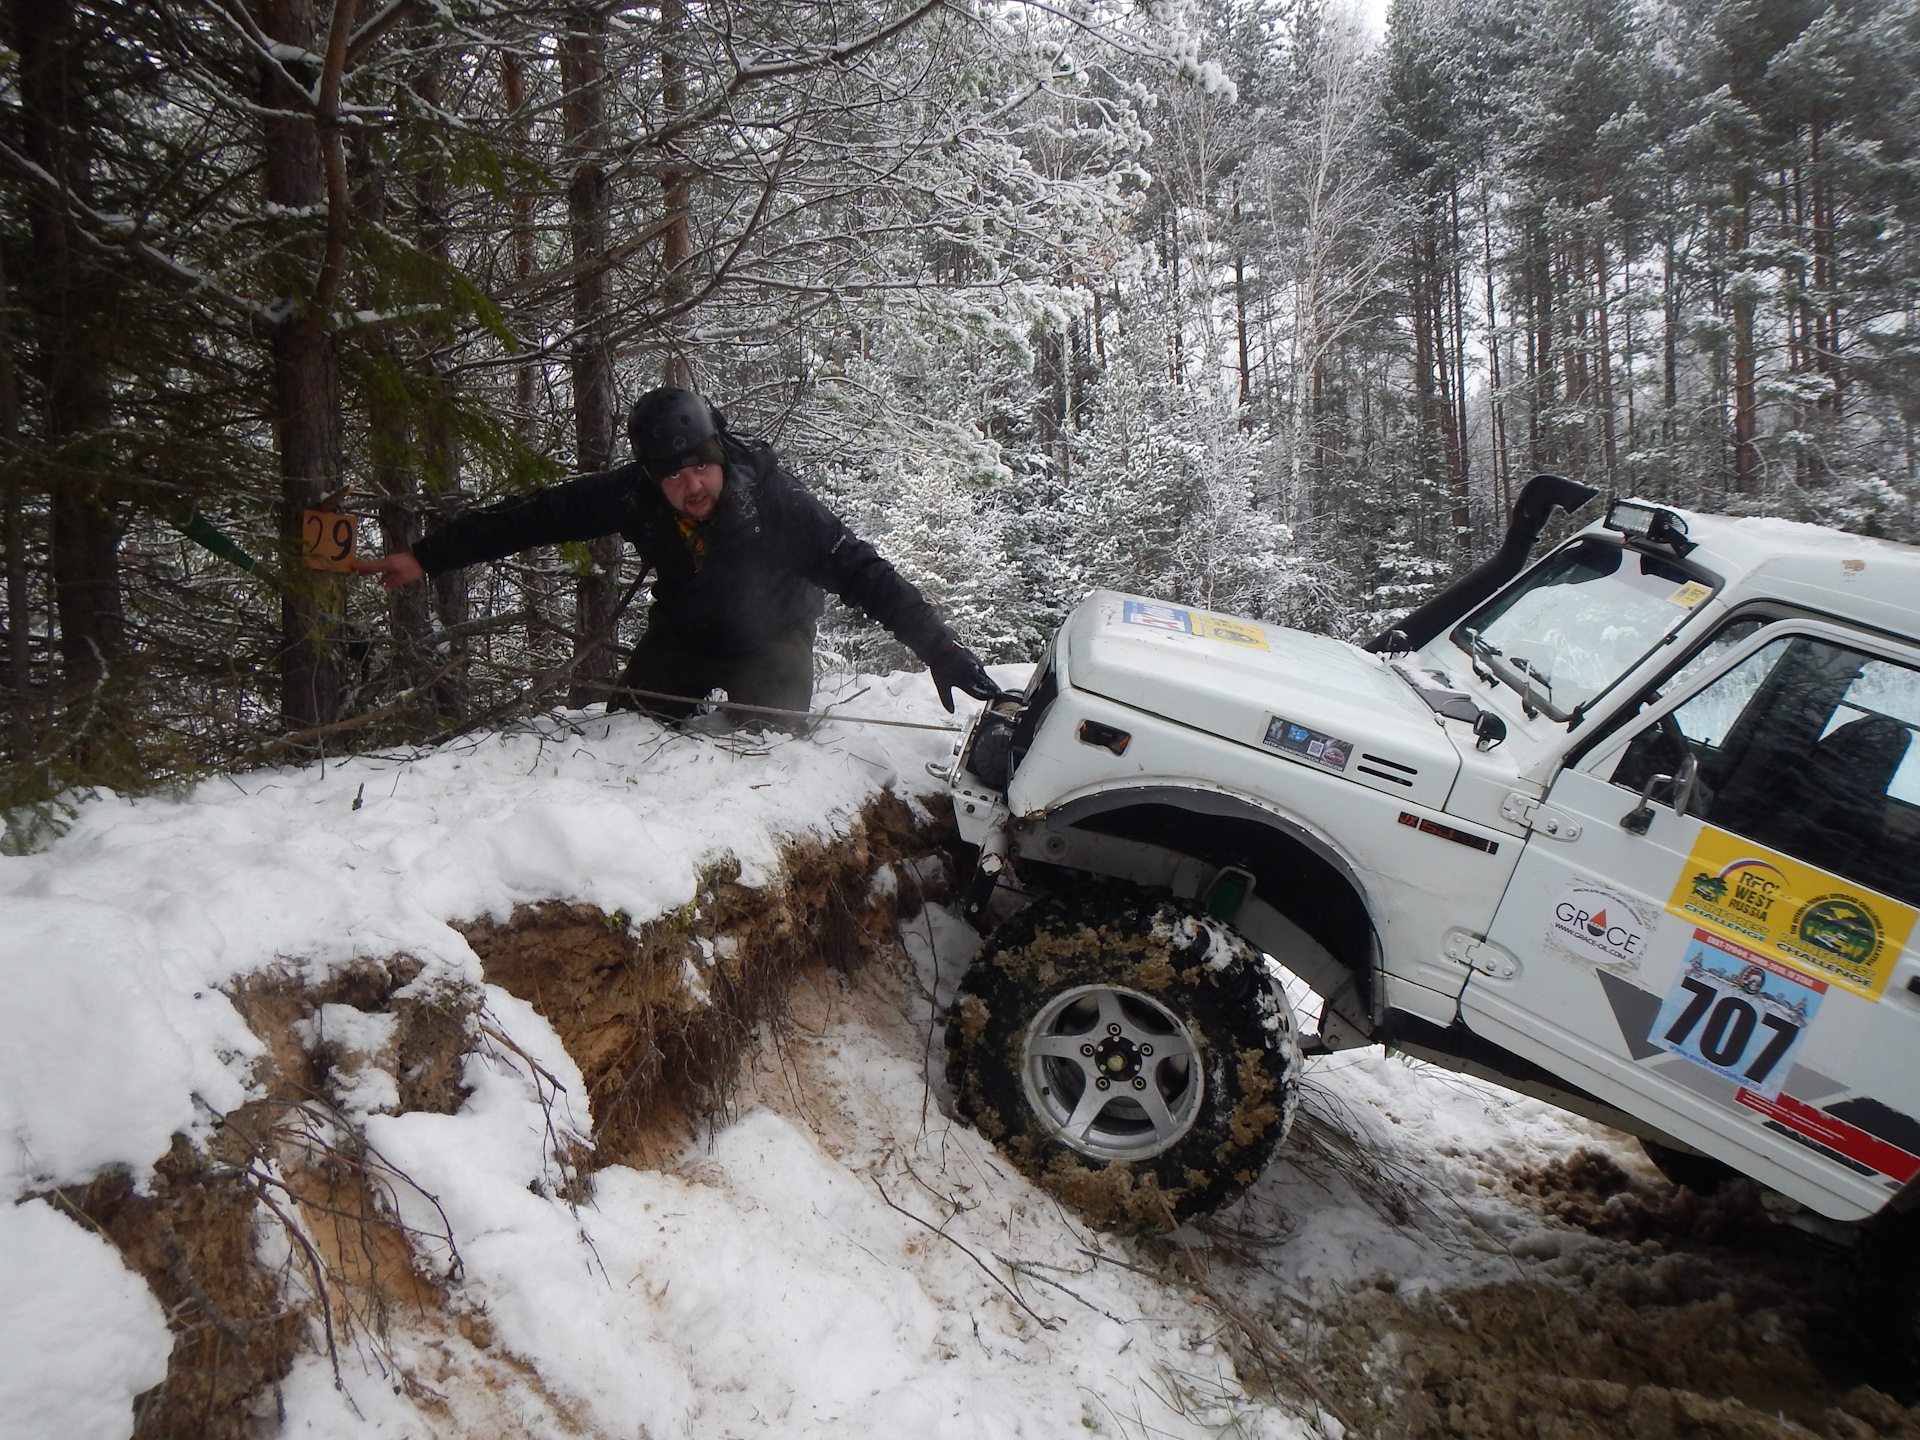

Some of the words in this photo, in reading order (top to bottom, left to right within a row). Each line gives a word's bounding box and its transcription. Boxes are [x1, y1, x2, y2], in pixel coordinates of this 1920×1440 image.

[307, 515, 353, 562] 29
[1686, 895, 1770, 934] RAINFOREST
[1728, 898, 1768, 922] RUSSIA
[1735, 884, 1775, 910] WEST
[1555, 922, 1626, 960] WWW.GRACE-OIL.COM
[1684, 903, 1767, 942] CHALLENGE
[1776, 942, 1872, 988] CHALLENGE
[1664, 976, 1800, 1084] 707
